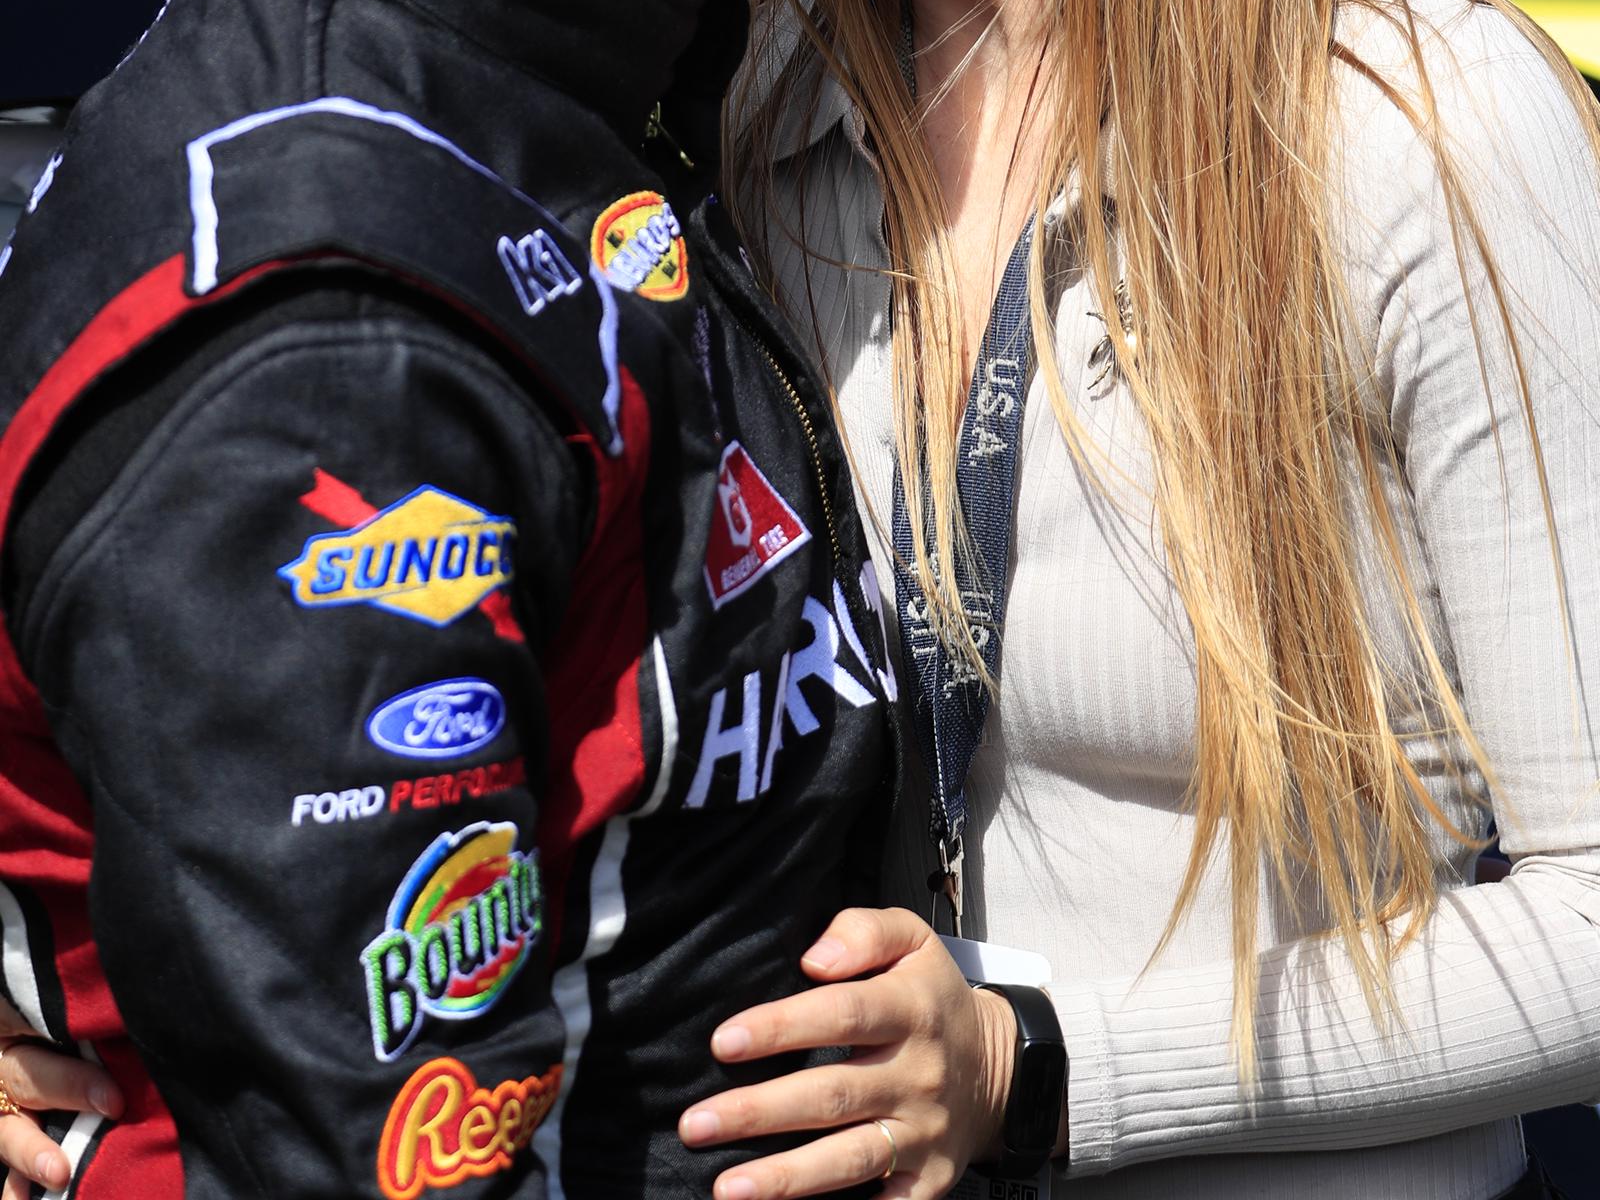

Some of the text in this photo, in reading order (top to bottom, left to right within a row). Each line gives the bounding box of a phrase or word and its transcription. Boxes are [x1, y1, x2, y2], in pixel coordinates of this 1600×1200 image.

[970, 356, 1020, 463] USA
[402, 692, 493, 747] Ford
[291, 784, 386, 827] FORD
